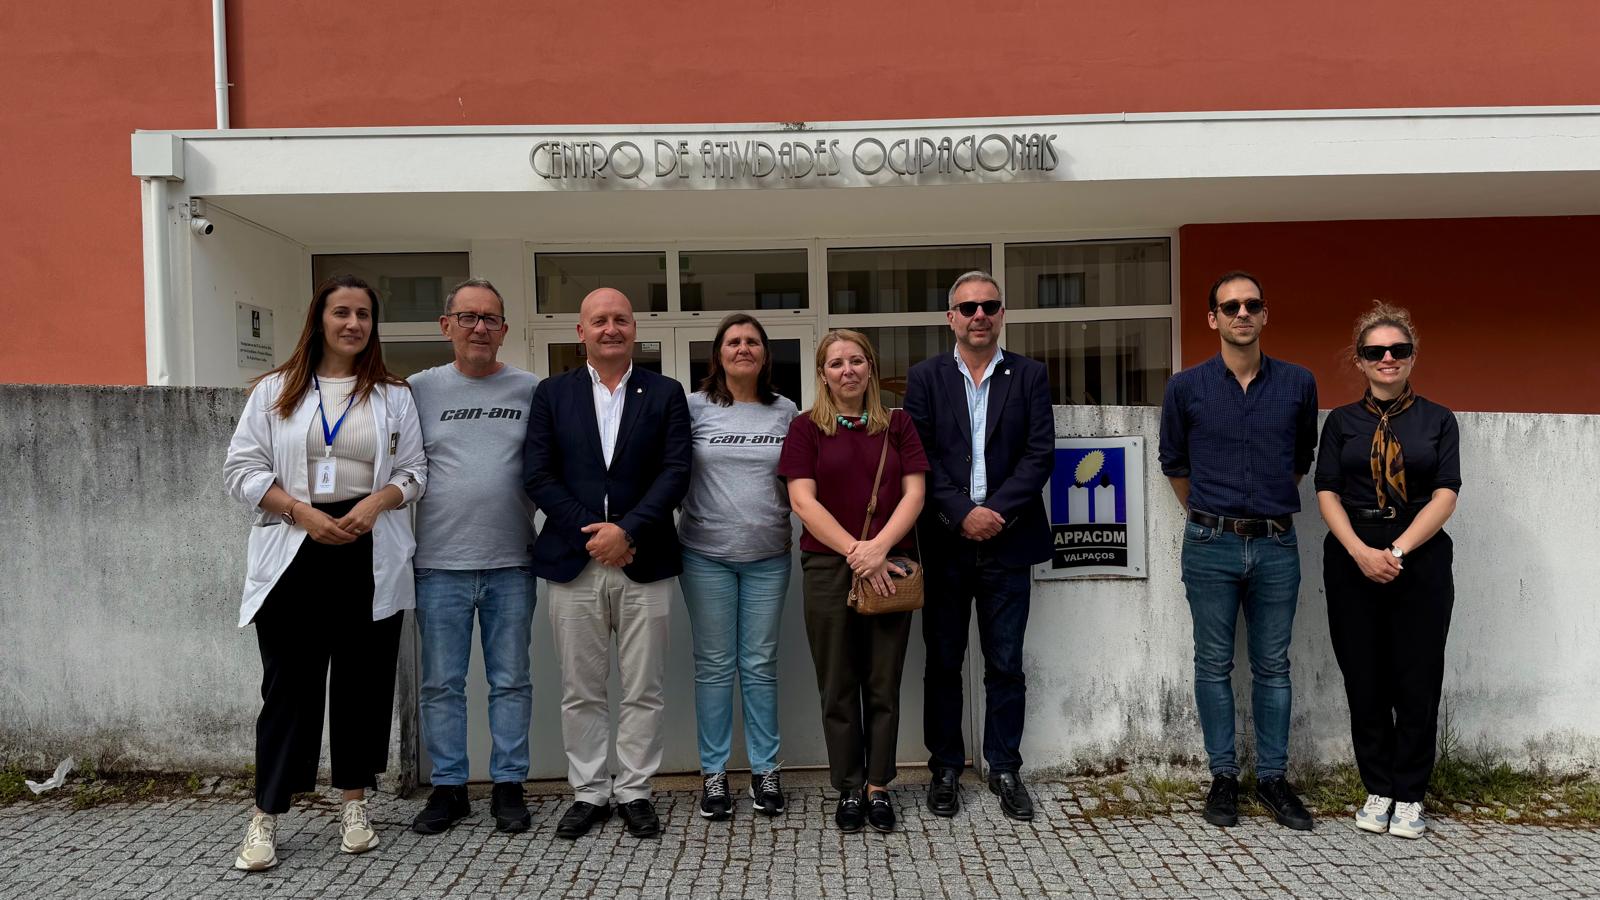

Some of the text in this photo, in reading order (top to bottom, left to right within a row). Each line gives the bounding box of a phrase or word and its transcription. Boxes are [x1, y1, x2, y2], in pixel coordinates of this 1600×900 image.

[529, 133, 1059, 179] CENTRO DE ATIVIDADES OCUPACIONAIS
[440, 407, 522, 421] can-am
[709, 435, 781, 444] can-am
[1053, 530, 1126, 545] APPACDM
[1063, 552, 1115, 562] VALPAÇOS
